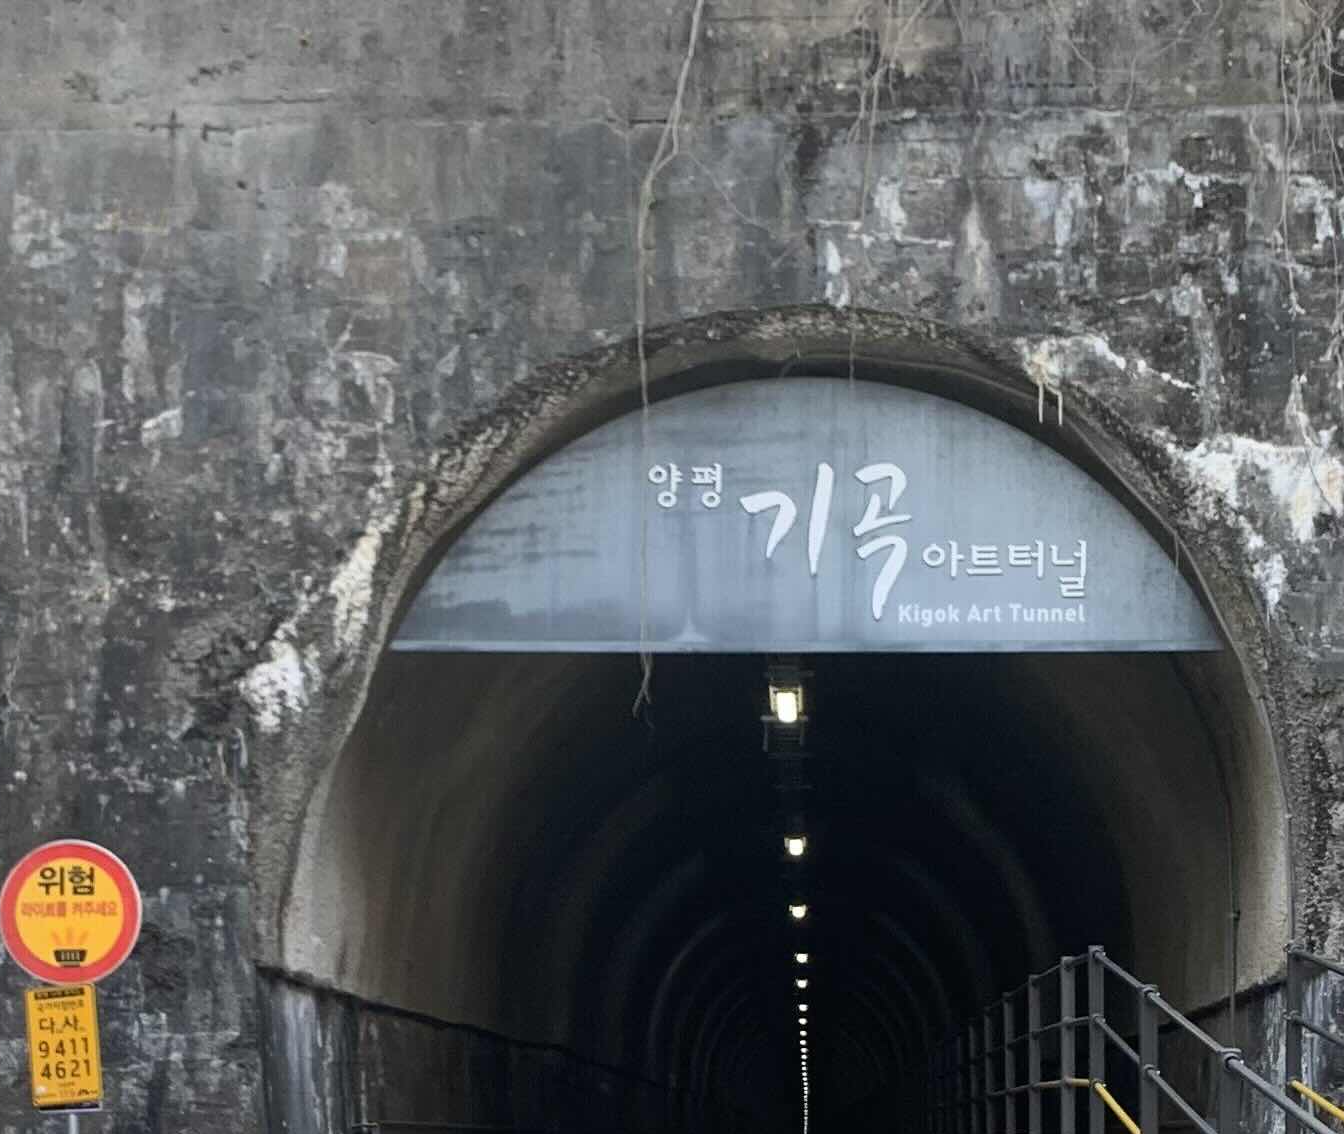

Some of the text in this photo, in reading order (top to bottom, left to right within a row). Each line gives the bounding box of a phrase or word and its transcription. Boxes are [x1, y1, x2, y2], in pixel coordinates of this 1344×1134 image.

[648, 462, 1088, 621] 양평 기곡 아트터널
[898, 602, 1087, 628] Kigok Art Tunnel
[37, 865, 96, 896] 위험
[38, 1037, 89, 1058] 9411
[40, 1059, 91, 1080] 4621
